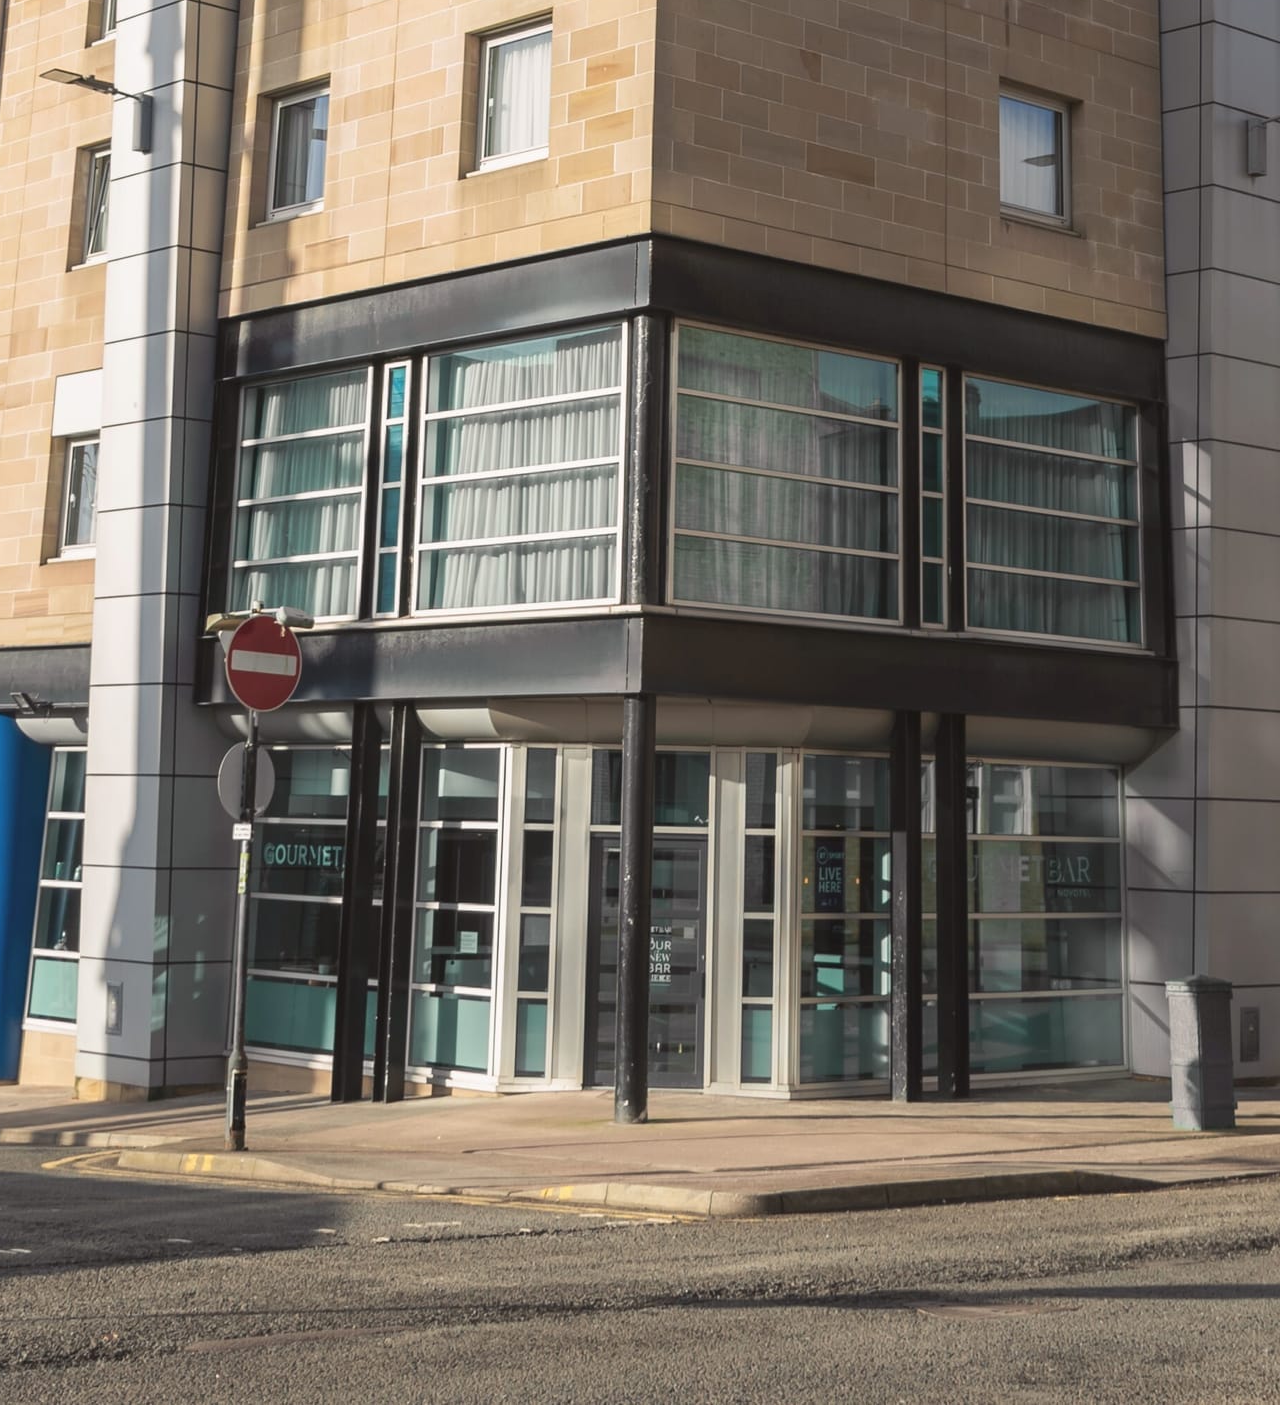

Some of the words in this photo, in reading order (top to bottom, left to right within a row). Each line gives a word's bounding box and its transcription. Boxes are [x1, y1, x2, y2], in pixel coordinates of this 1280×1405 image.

[263, 842, 342, 867] GOURMET
[819, 866, 842, 881] LIVE
[819, 881, 842, 894] HERE
